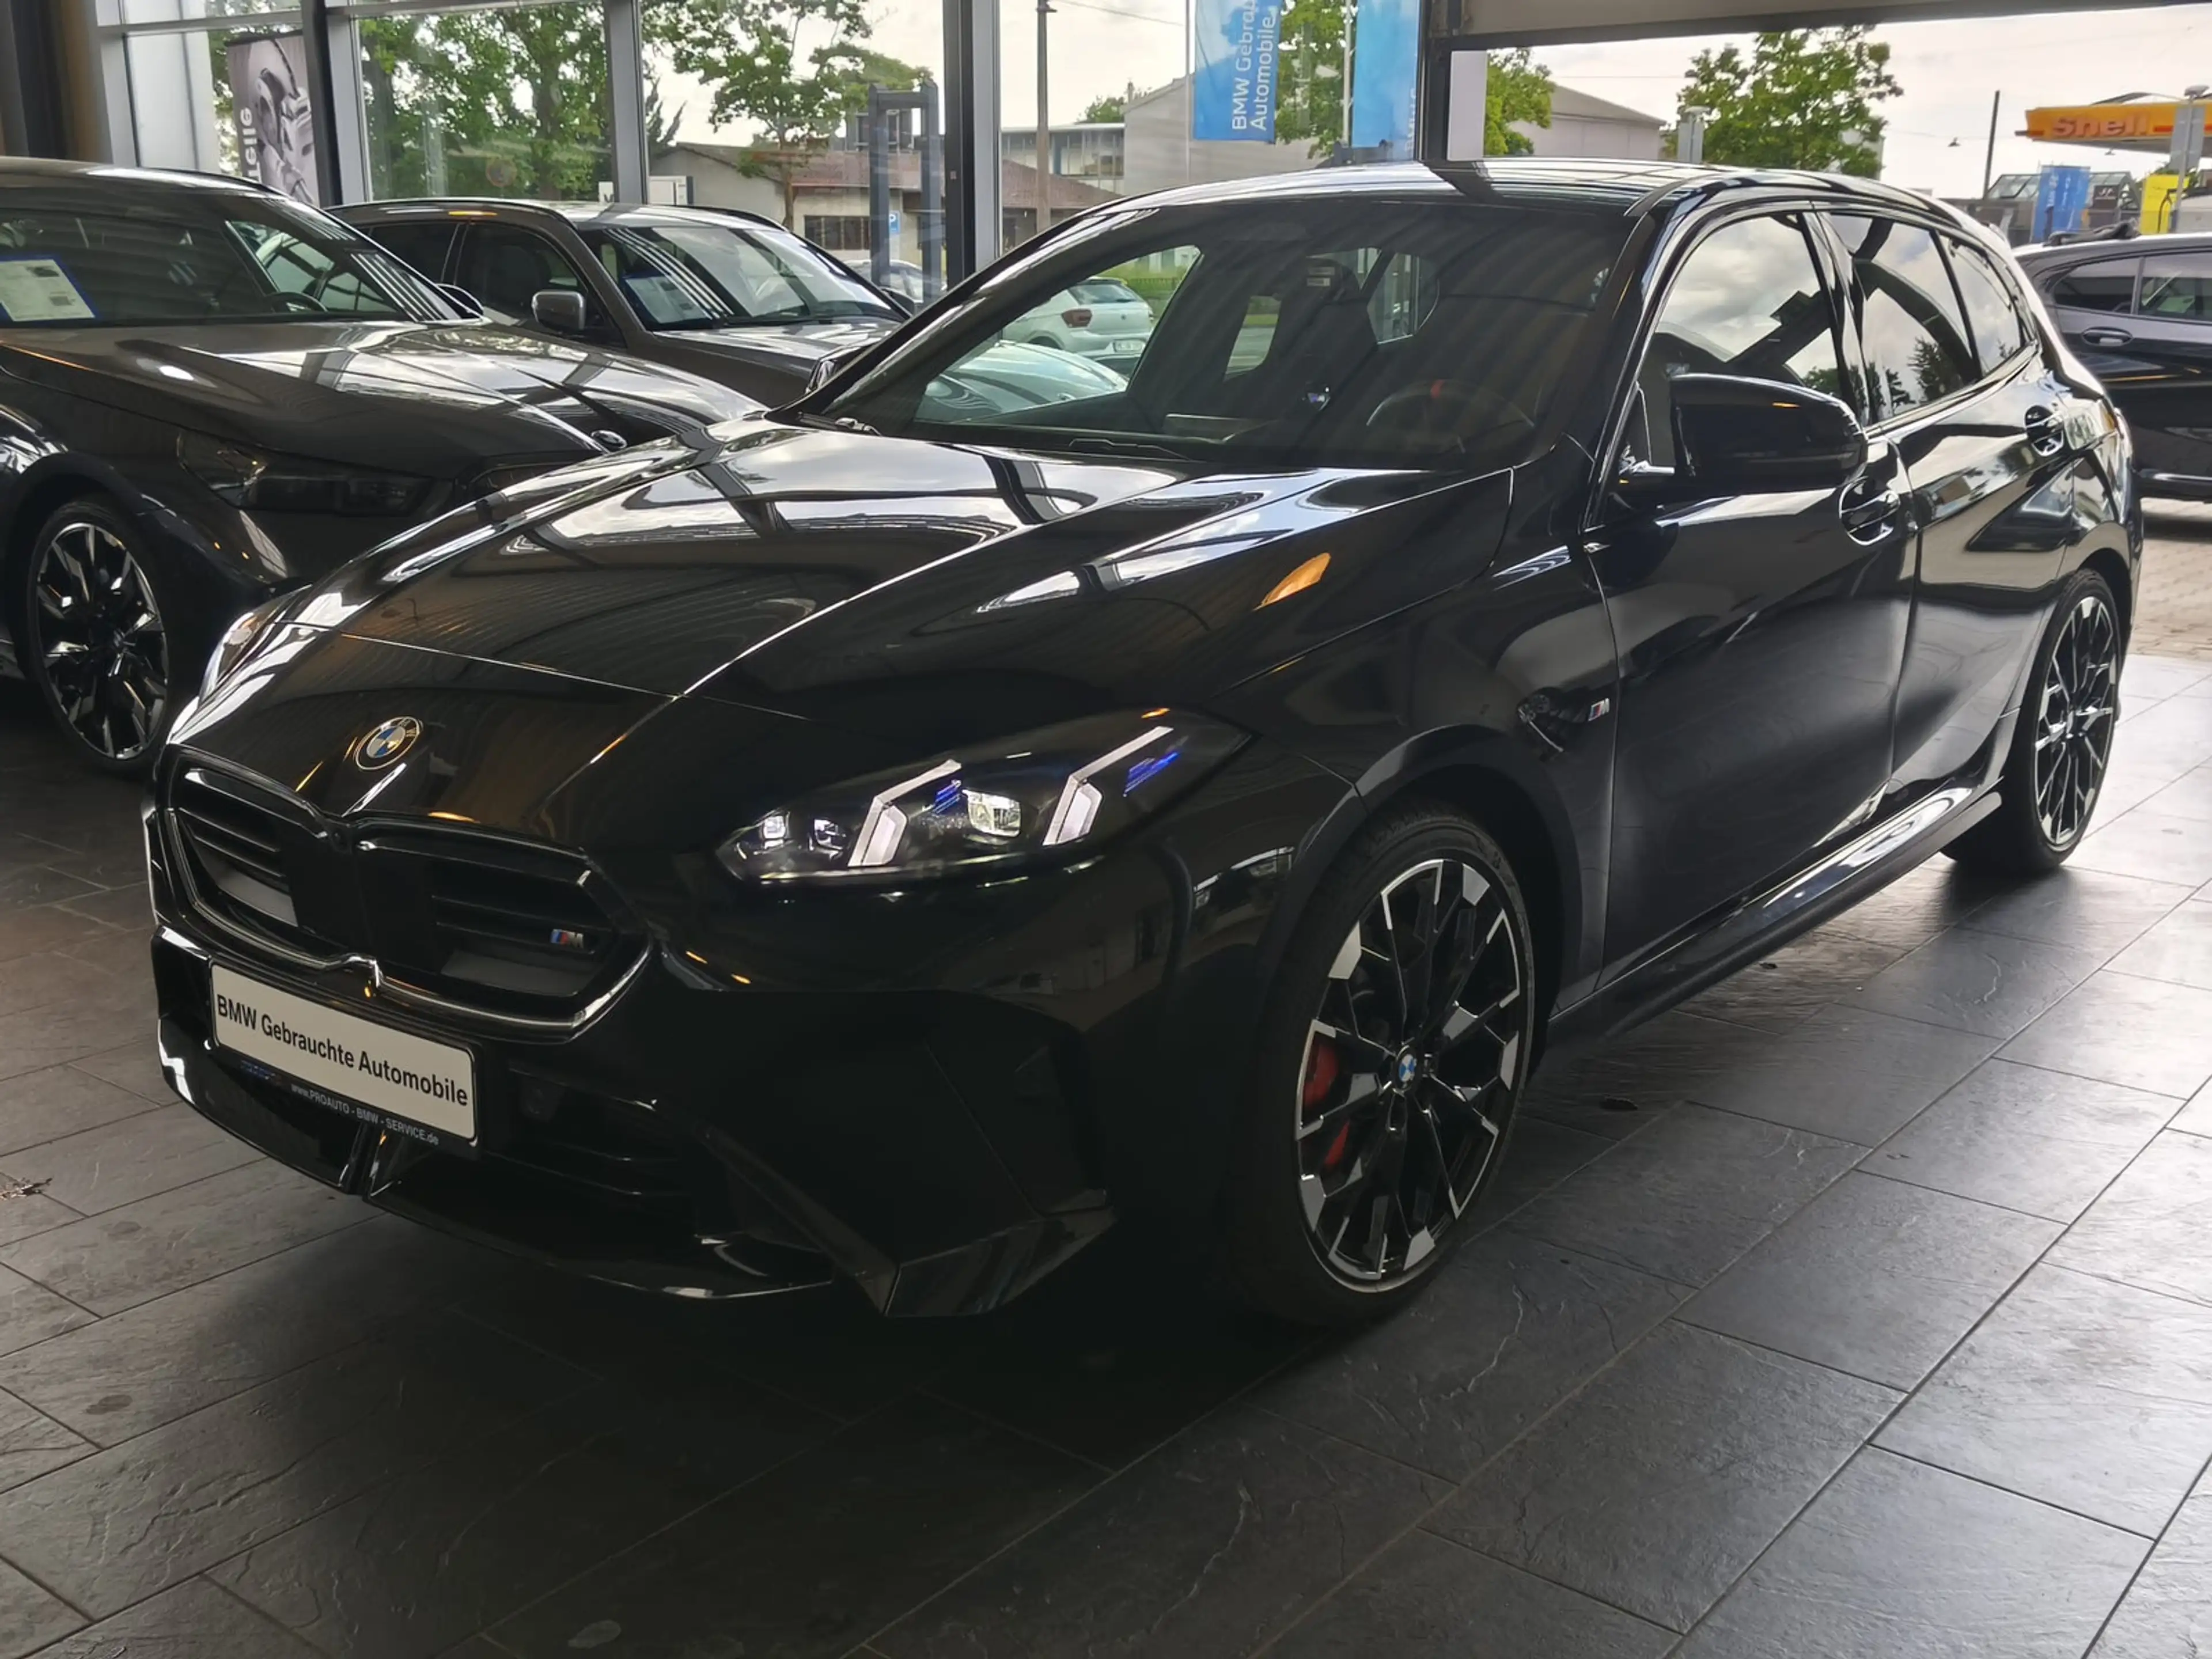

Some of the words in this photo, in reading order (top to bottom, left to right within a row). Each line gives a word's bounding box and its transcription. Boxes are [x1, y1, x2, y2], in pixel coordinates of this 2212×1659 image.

[1232, 77, 1250, 130] BMW
[1249, 16, 1276, 131] Automobile
[2052, 112, 2148, 137] Shell
[217, 994, 257, 1031] BMW
[261, 1009, 355, 1069] Gebrauchte
[358, 1050, 468, 1107] Automobile
[290, 1083, 350, 1114] www.PROAUTO
[356, 1107, 380, 1124] BMW
[385, 1118, 440, 1146] SERVICE.de
